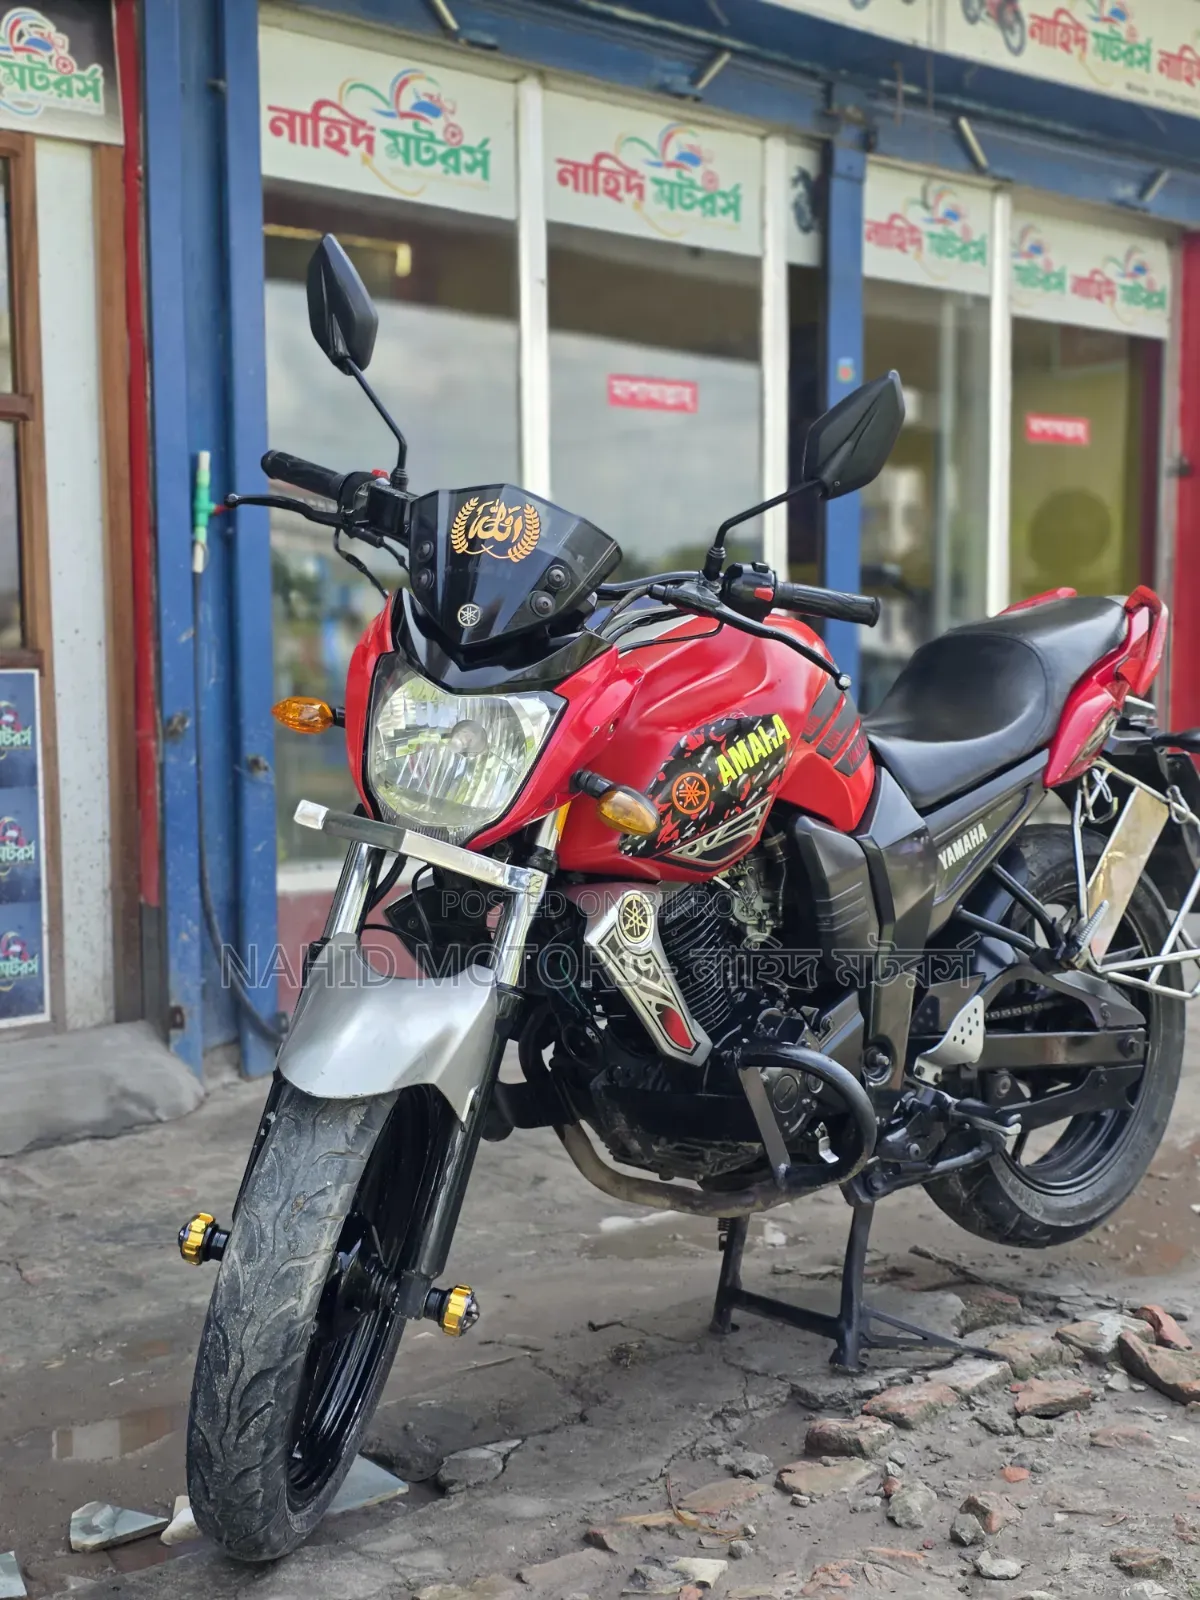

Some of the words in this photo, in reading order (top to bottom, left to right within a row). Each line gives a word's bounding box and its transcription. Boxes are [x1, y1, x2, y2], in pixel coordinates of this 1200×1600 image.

[1158, 43, 1200, 88] নাহি
[267, 98, 376, 157] নাহিদ
[555, 152, 646, 204] নাহিদ
[938, 822, 988, 870] YAMAHA
